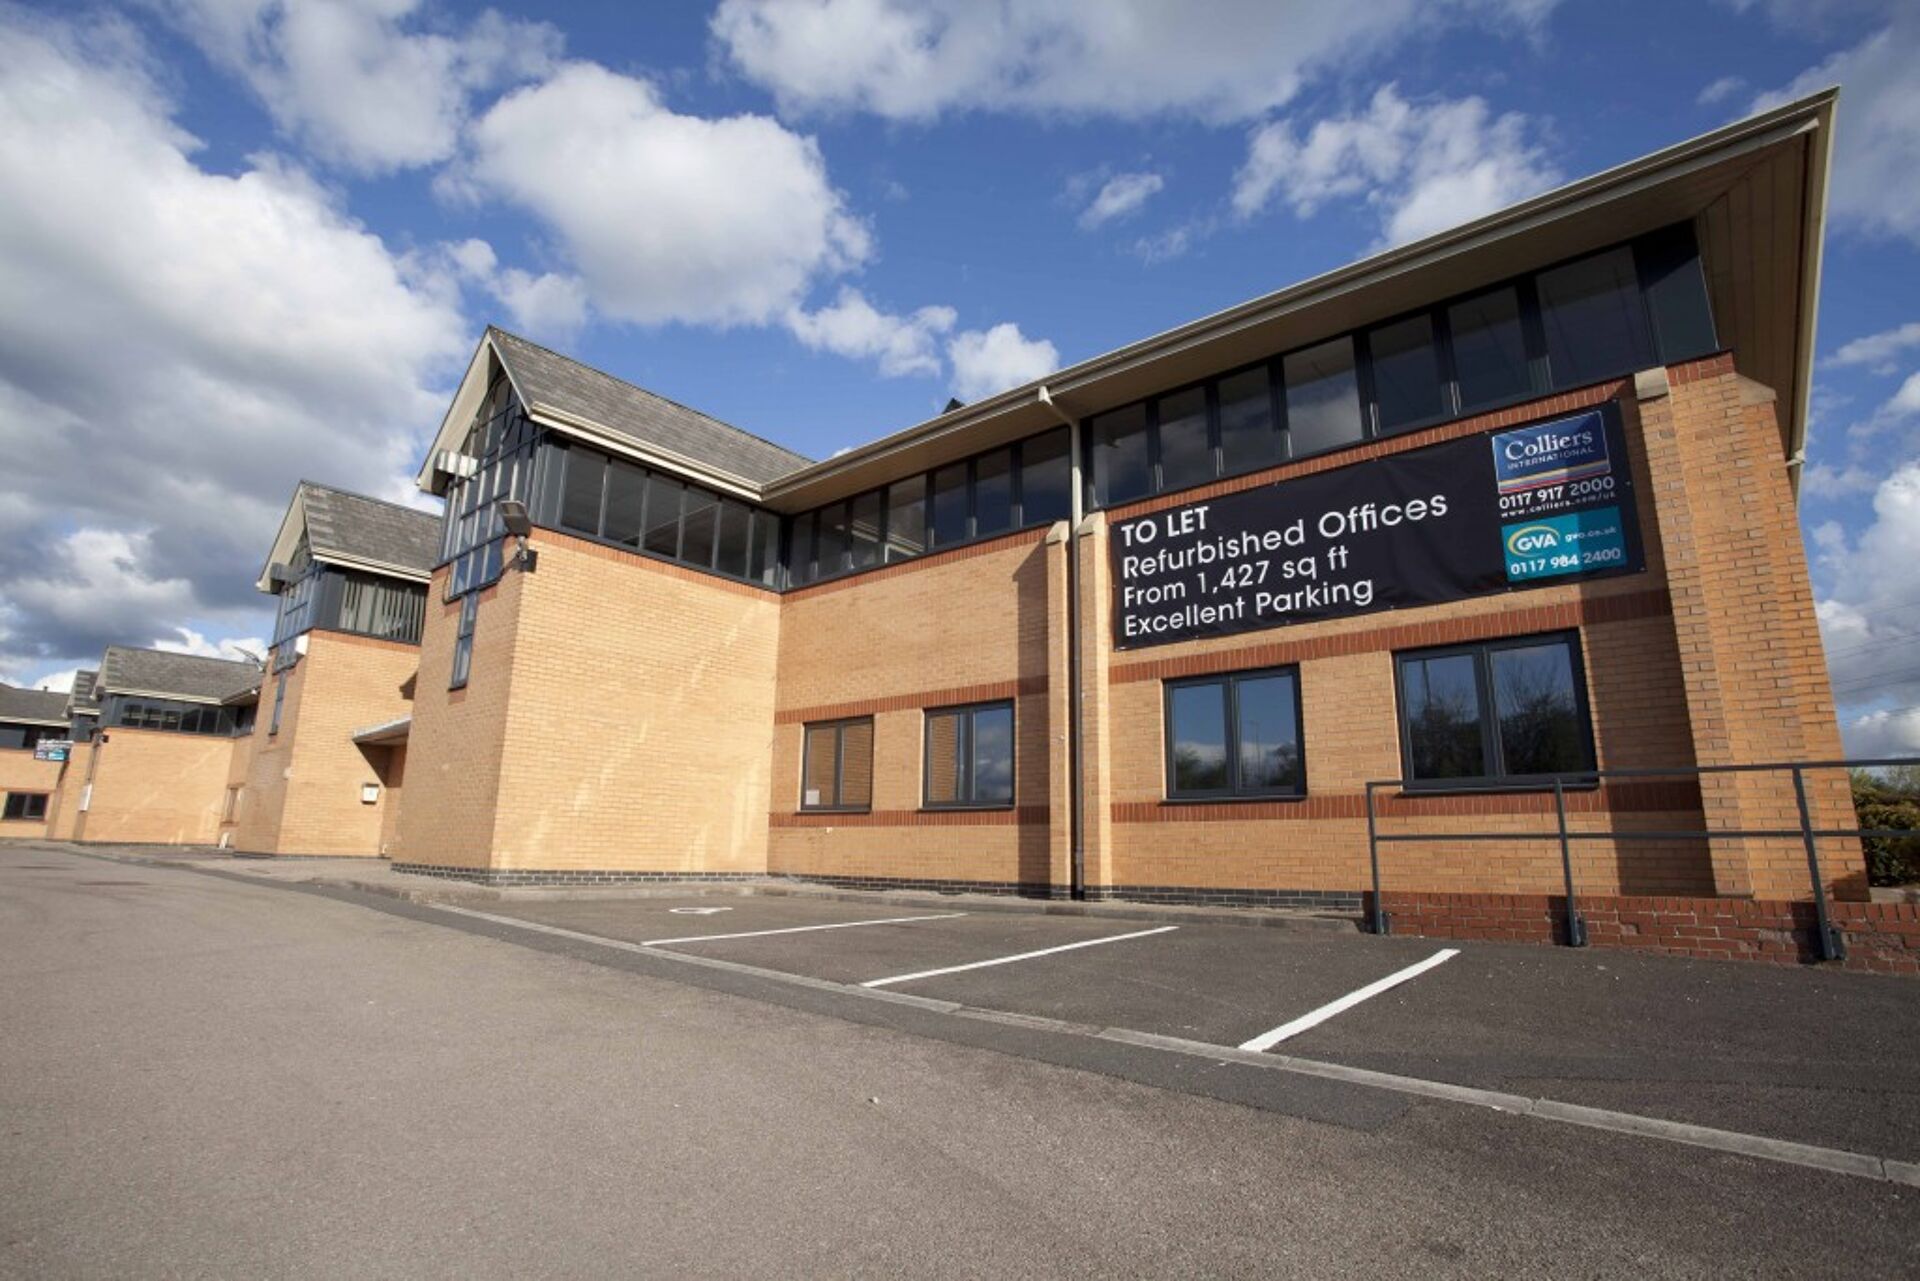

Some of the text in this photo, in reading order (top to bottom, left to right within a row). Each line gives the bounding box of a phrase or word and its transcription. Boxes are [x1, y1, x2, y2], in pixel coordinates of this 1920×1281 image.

[1505, 431, 1593, 461] Colliers
[1507, 447, 1594, 470] INTERNATIONAL
[1500, 477, 1615, 509] 0117 917 2000
[1121, 506, 1210, 546] TO LET
[1123, 494, 1448, 578] Refurbished Offices
[1517, 533, 1557, 551] GVA
[1124, 545, 1349, 608] From 1,427 sq ft
[1511, 559, 1546, 575] 0117
[1583, 548, 1621, 564] 2400
[1125, 579, 1373, 637] Excellent Parking
